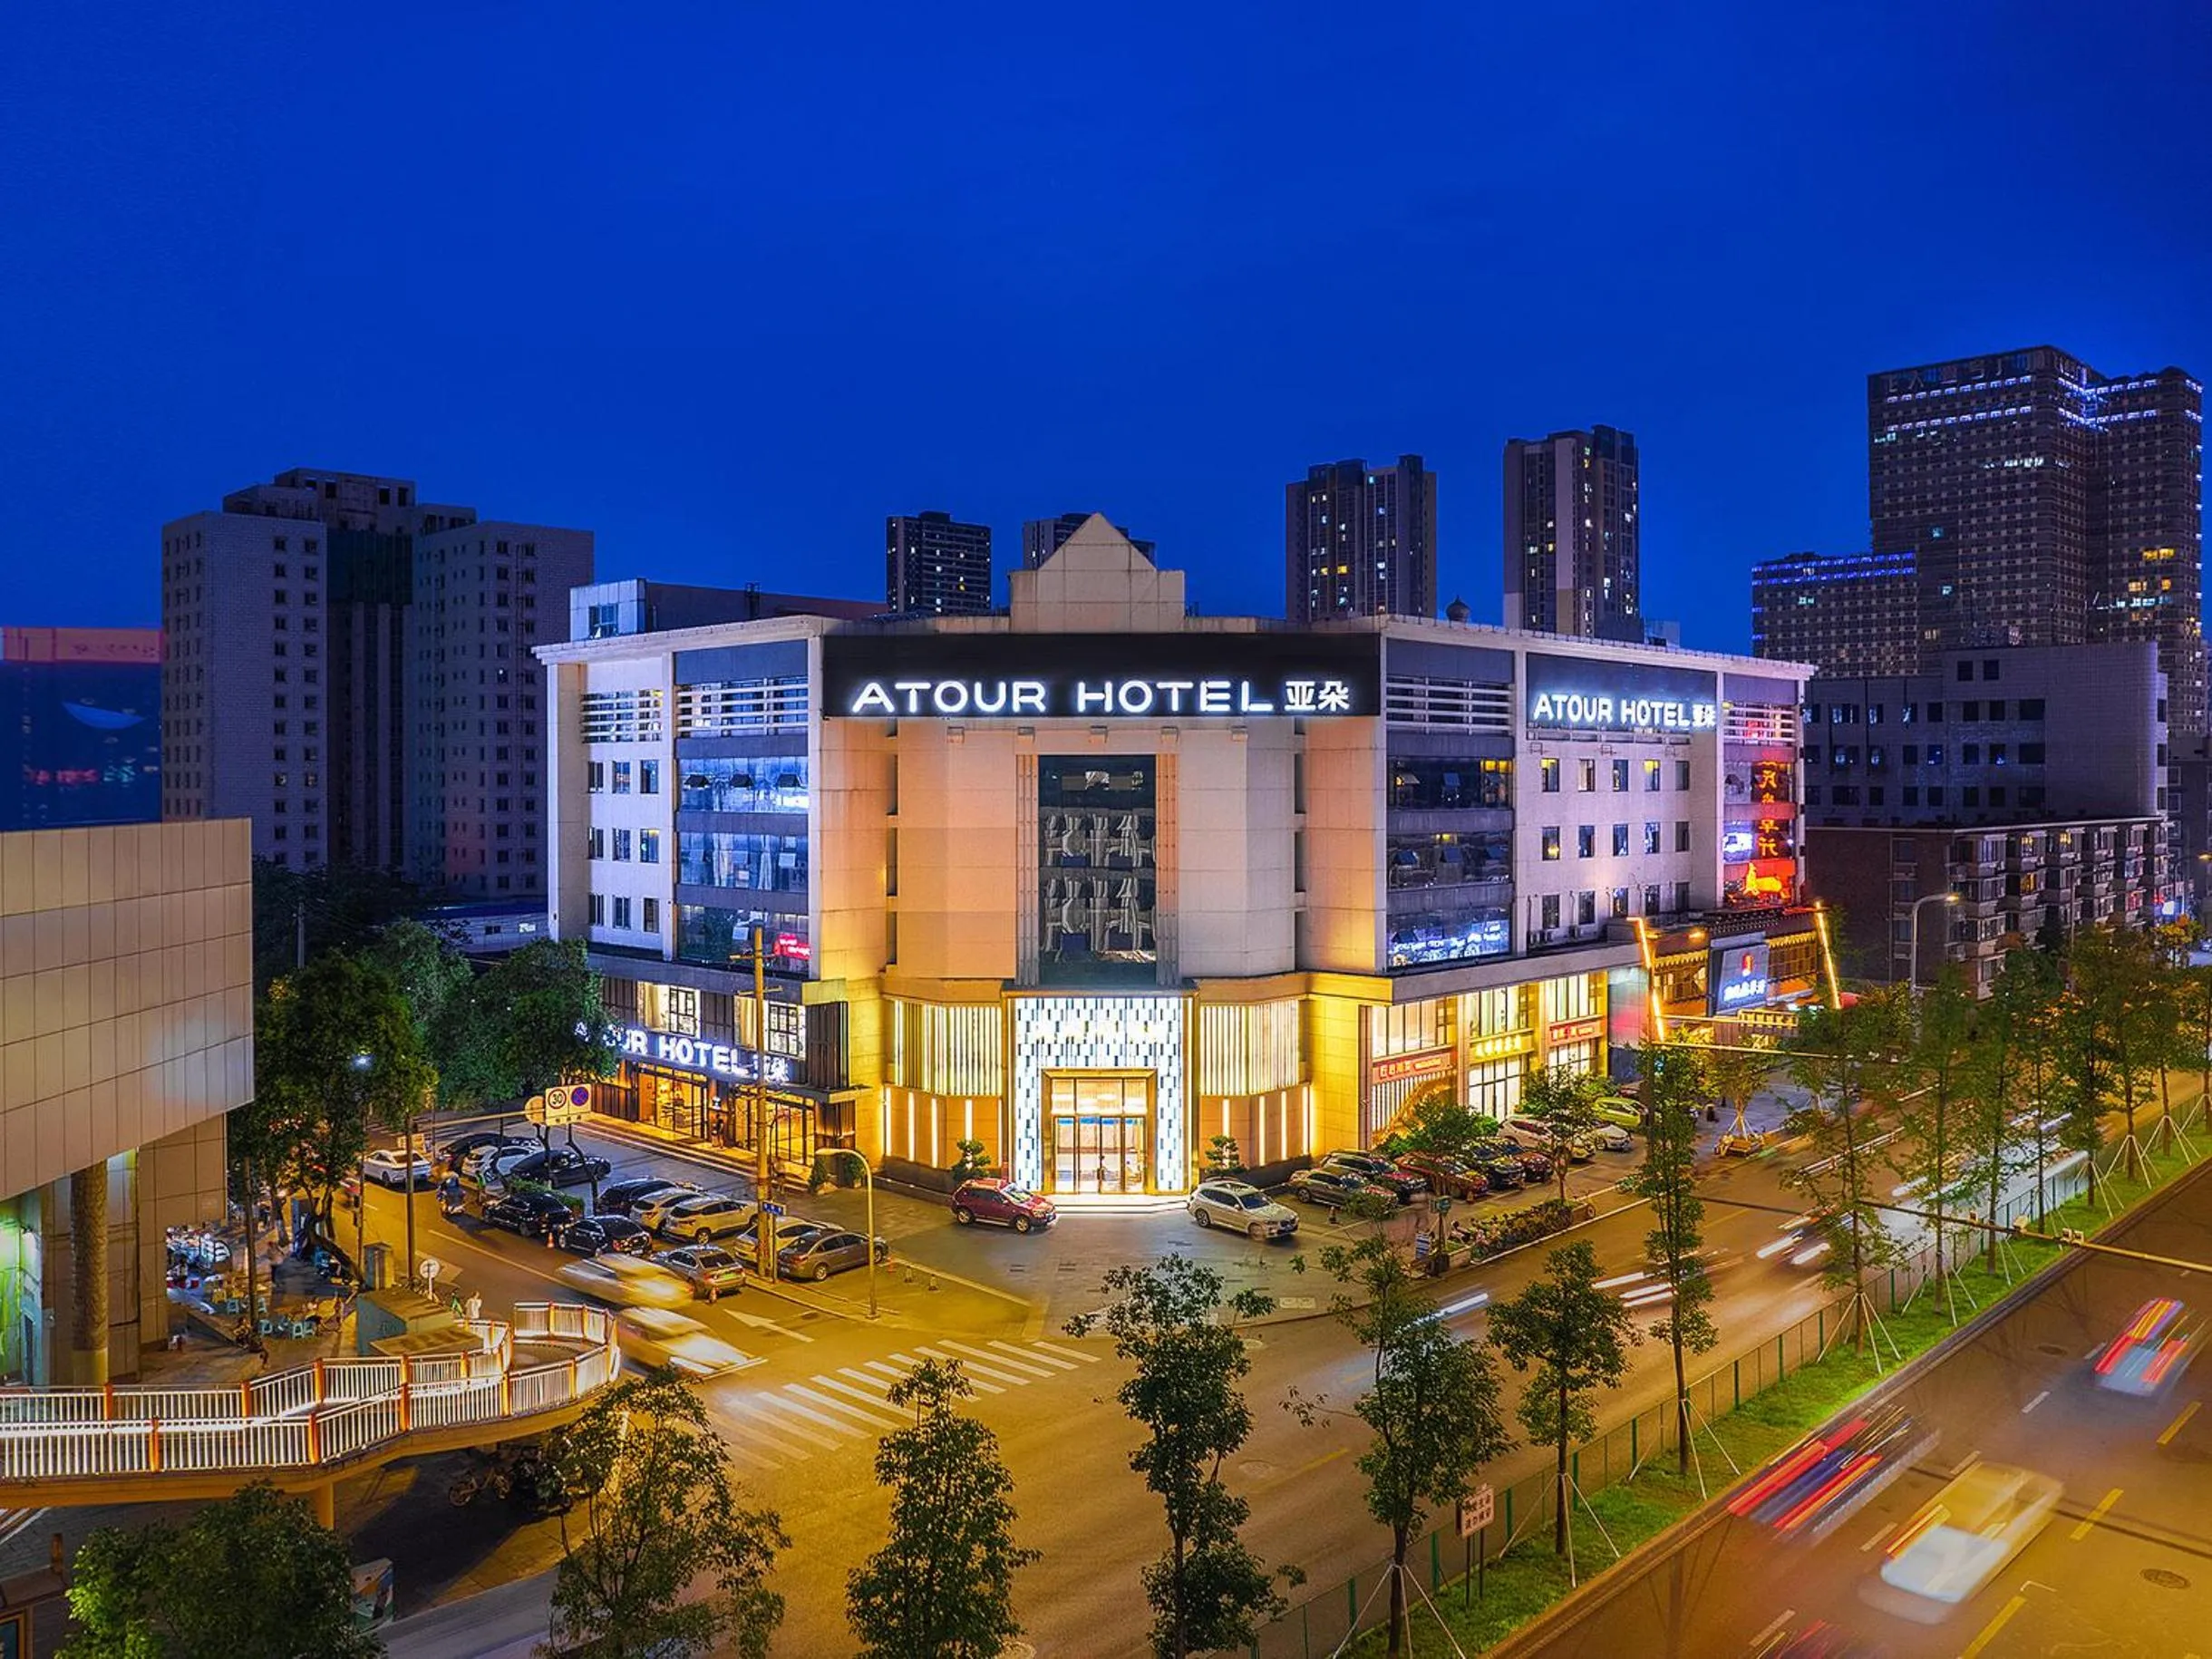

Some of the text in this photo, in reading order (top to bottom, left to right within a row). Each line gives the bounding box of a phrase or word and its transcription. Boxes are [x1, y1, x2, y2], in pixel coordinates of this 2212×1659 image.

[851, 680, 1274, 713] ATOUR HOTEL
[1284, 679, 1351, 712] 亚朵
[1533, 693, 1690, 727] ATOUR HOTEL
[659, 1034, 749, 1076] HOTEL
[552, 1092, 563, 1105] 30
